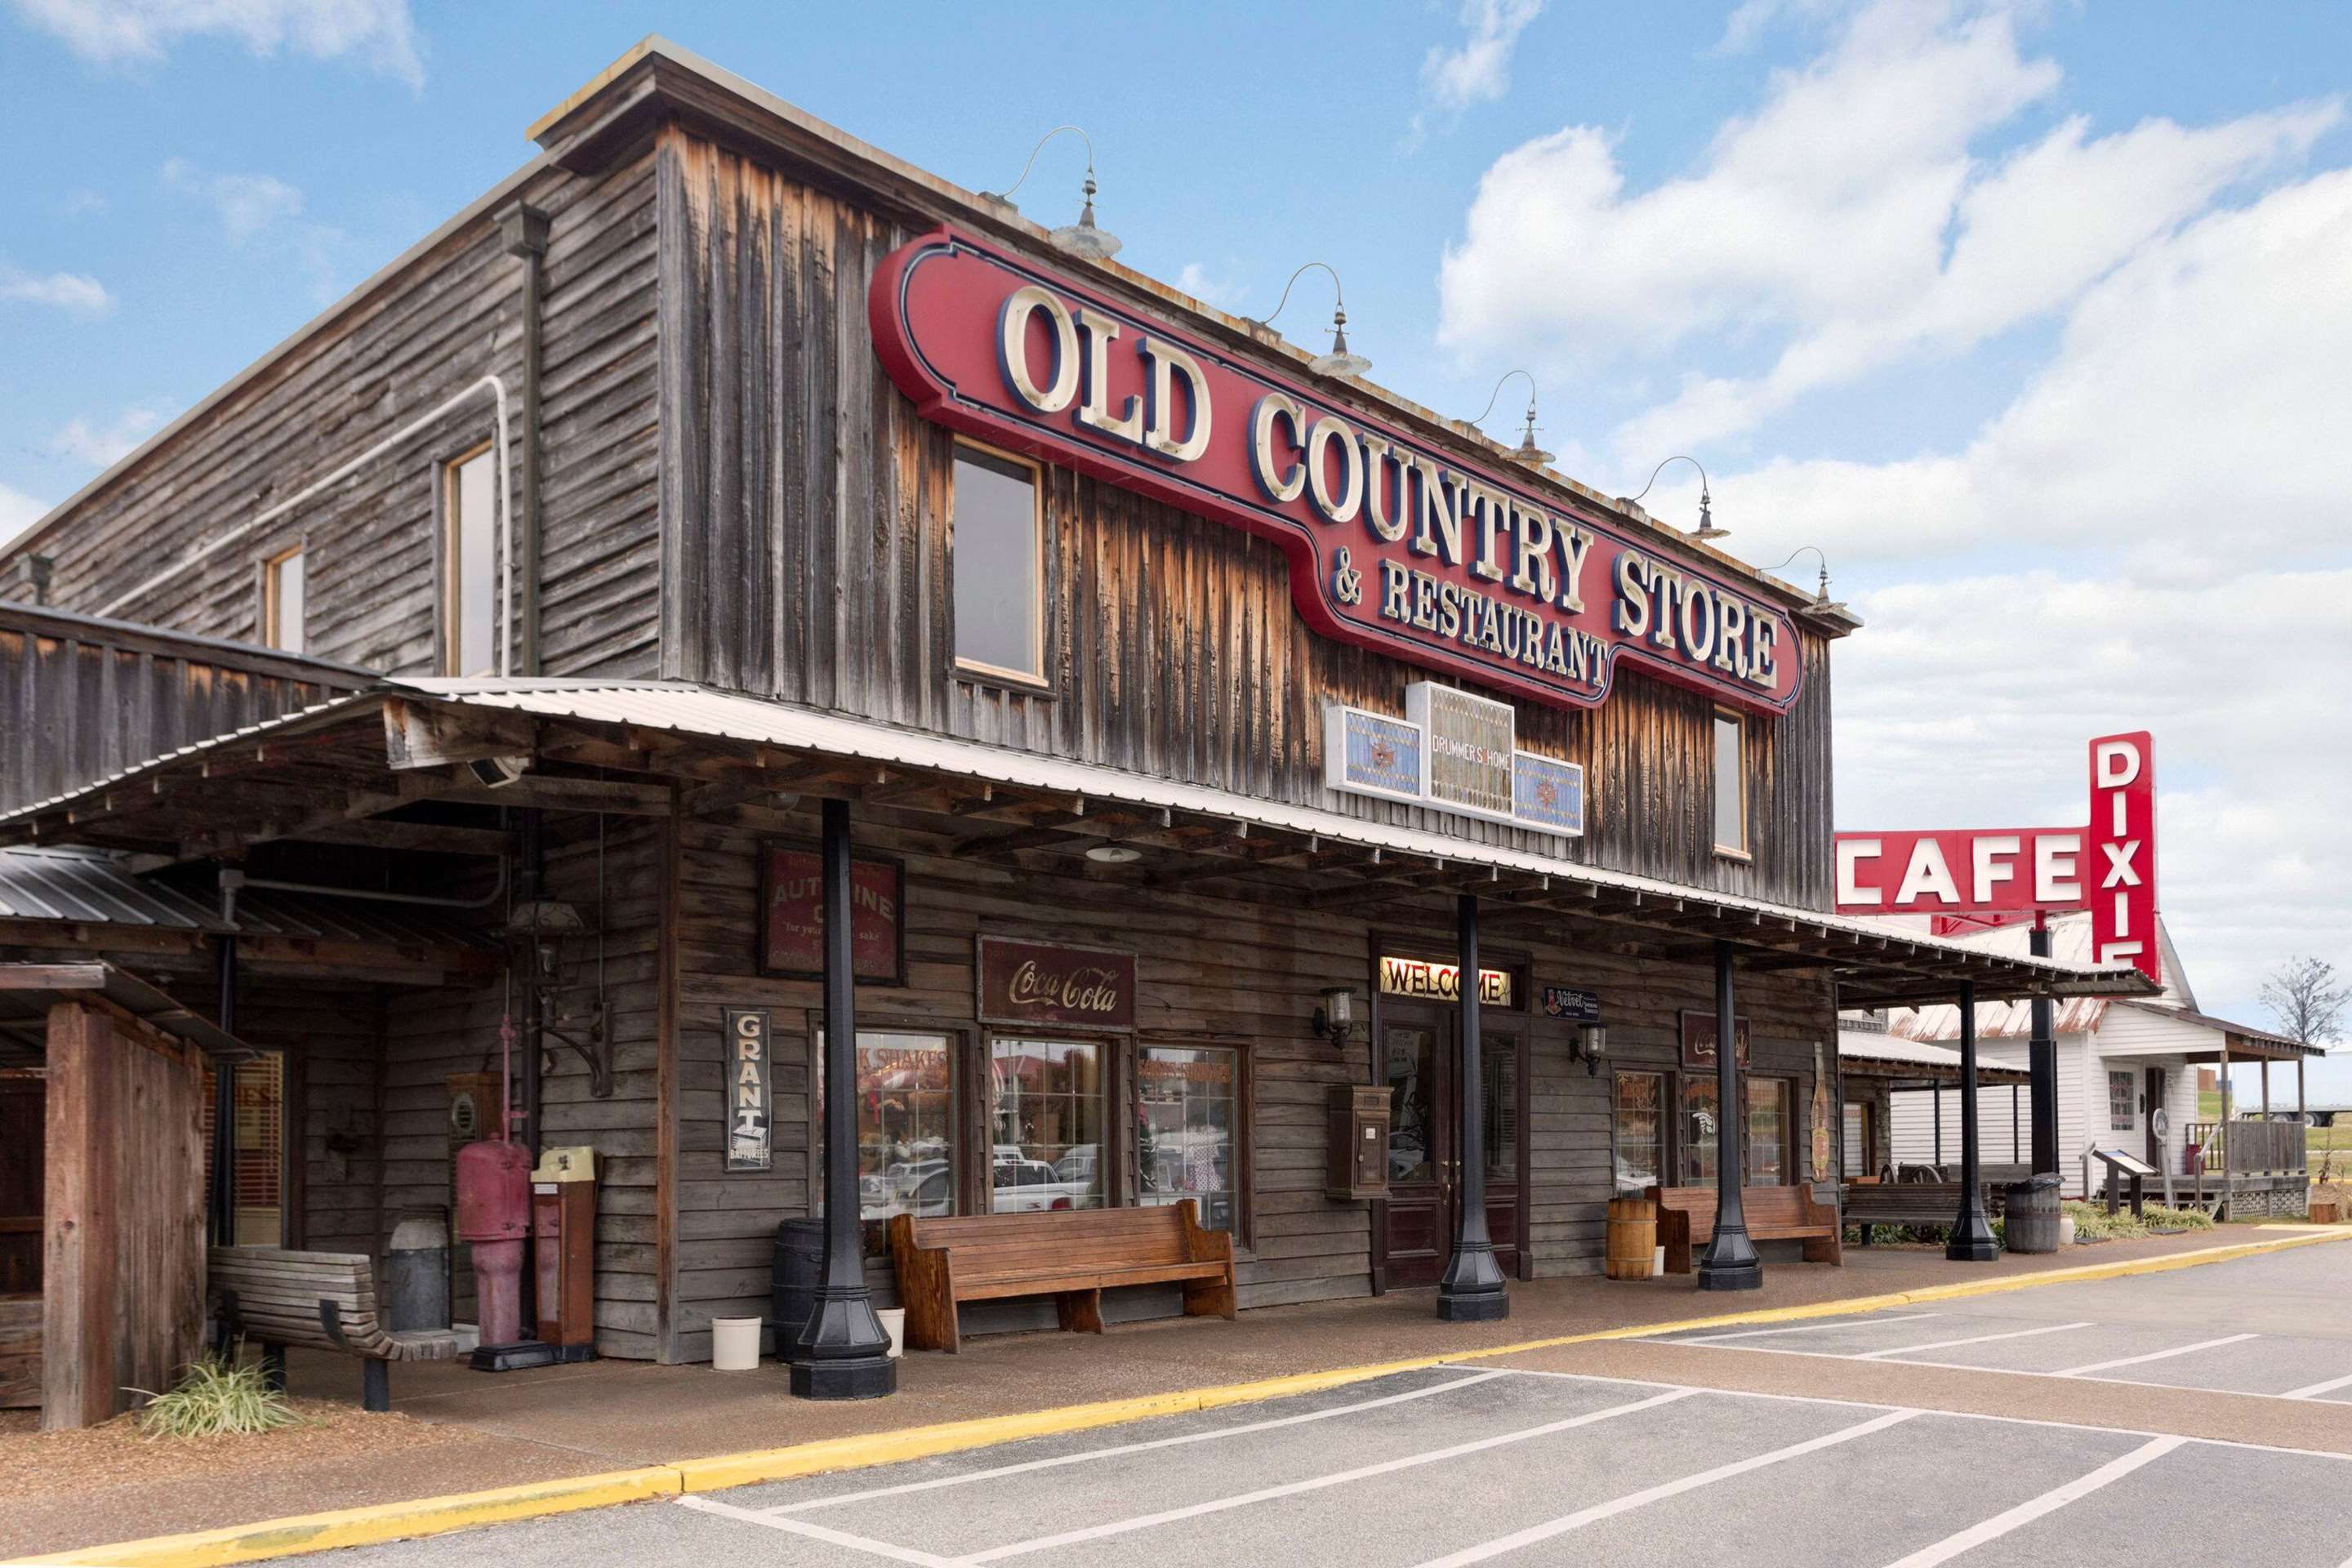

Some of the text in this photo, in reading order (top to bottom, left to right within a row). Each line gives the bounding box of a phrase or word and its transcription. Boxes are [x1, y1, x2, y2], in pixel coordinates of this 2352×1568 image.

[996, 286, 1778, 689] OLD COUNTRY STORE
[1330, 546, 1608, 689] & RESTAURANT
[1432, 735, 1510, 770] DRUMMER'S HOME
[771, 876, 894, 924] AUTINE
[1836, 834, 2082, 905] CAFE
[737, 1015, 763, 1131] GRANT
[875, 1048, 947, 1071] SHAKES
